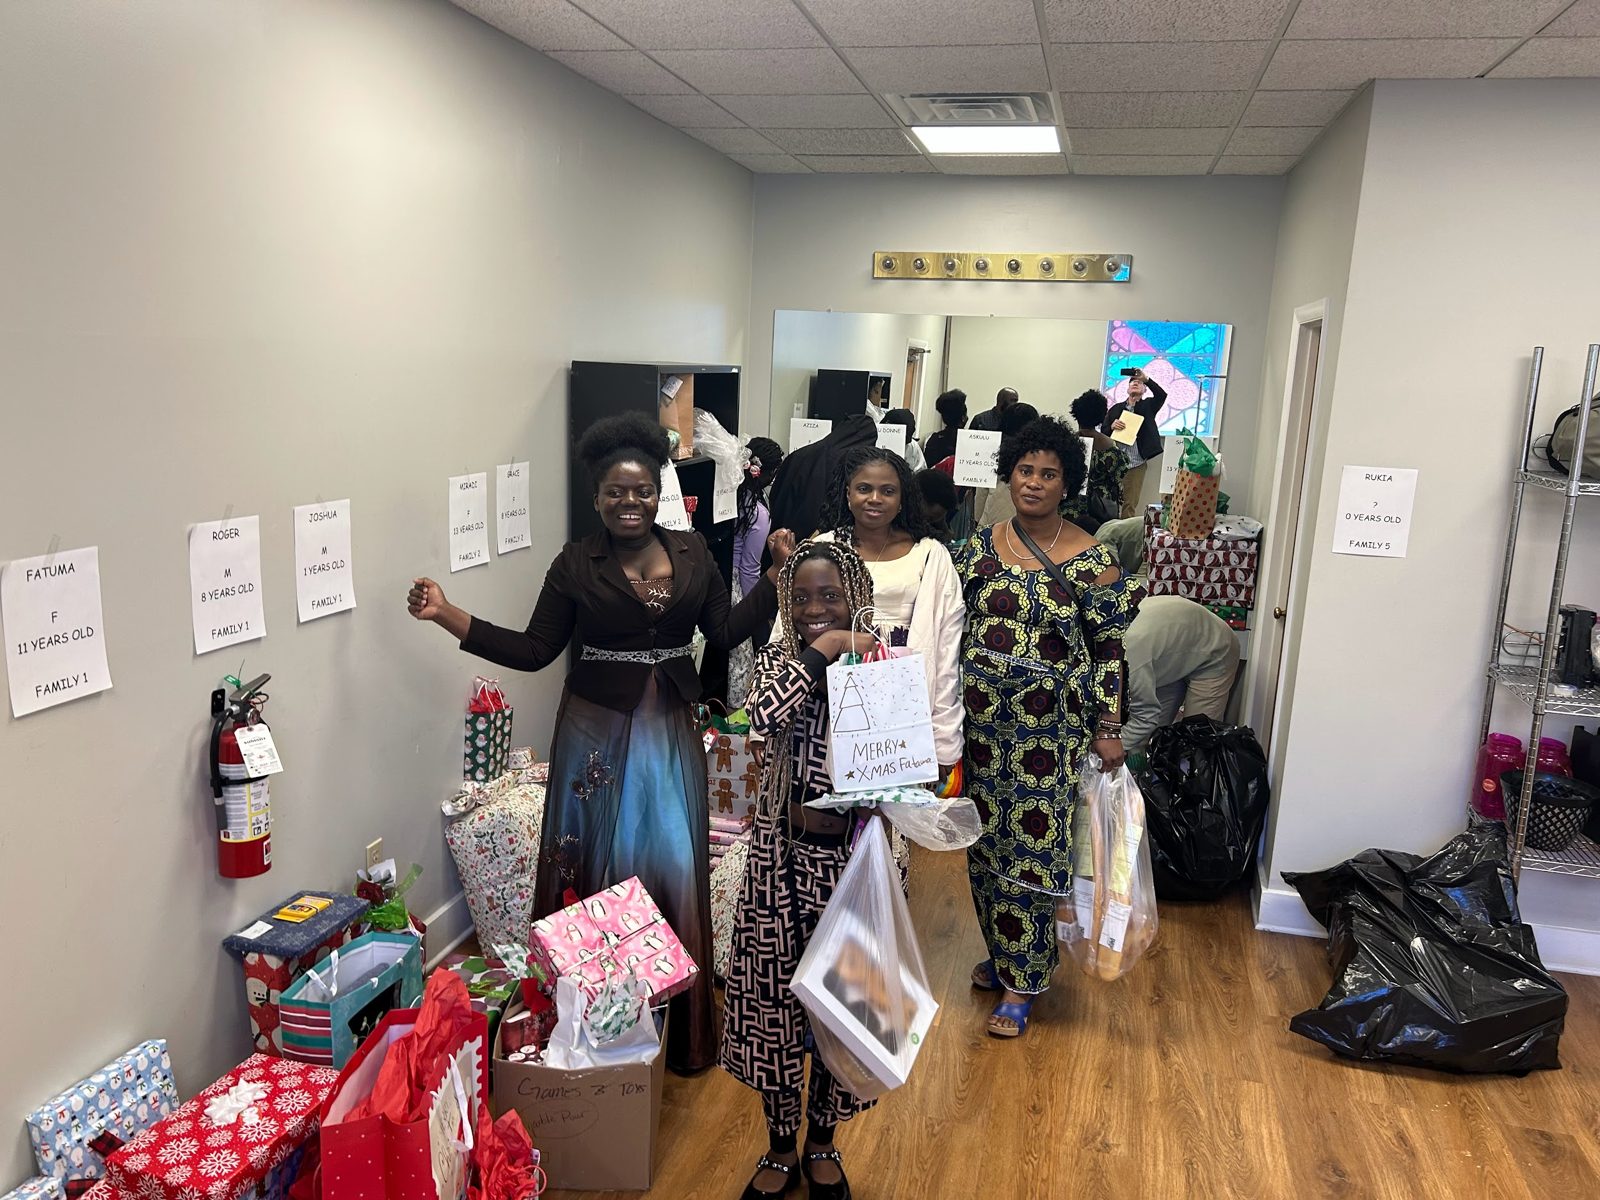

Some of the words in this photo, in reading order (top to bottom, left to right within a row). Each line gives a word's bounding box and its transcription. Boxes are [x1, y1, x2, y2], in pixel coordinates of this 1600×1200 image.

[309, 510, 337, 523] JOSHUA
[505, 509, 517, 518] YEARS
[1353, 513, 1381, 522] YEARS
[1384, 516, 1401, 524] OLD
[460, 523, 474, 533] YEARS
[475, 522, 484, 530] OLD
[213, 528, 240, 541] ROGER
[505, 536, 520, 544] FAMILY
[321, 546, 327, 555] M
[1349, 540, 1382, 549] FAMILY
[459, 552, 477, 562] FAMILY
[26, 563, 75, 582] FATUMA
[224, 568, 232, 578] M
[309, 563, 330, 575] YEARS
[332, 560, 345, 570] OLD
[201, 592, 206, 602] 8
[208, 587, 235, 601] YEARS
[238, 582, 254, 594] OLD
[312, 595, 337, 610] FAMILY
[51, 611, 58, 623] F
[211, 623, 243, 639] FAMILY
[245, 621, 249, 631] 1
[18, 642, 28, 655] 11
[31, 632, 69, 651] YEARS
[72, 626, 94, 640] OLD
[35, 674, 79, 698] FAMILY
[83, 672, 88, 683] 1
[852, 739, 899, 765] MERRY
[856, 762, 897, 783] XMAS
[518, 1077, 582, 1101] Games
